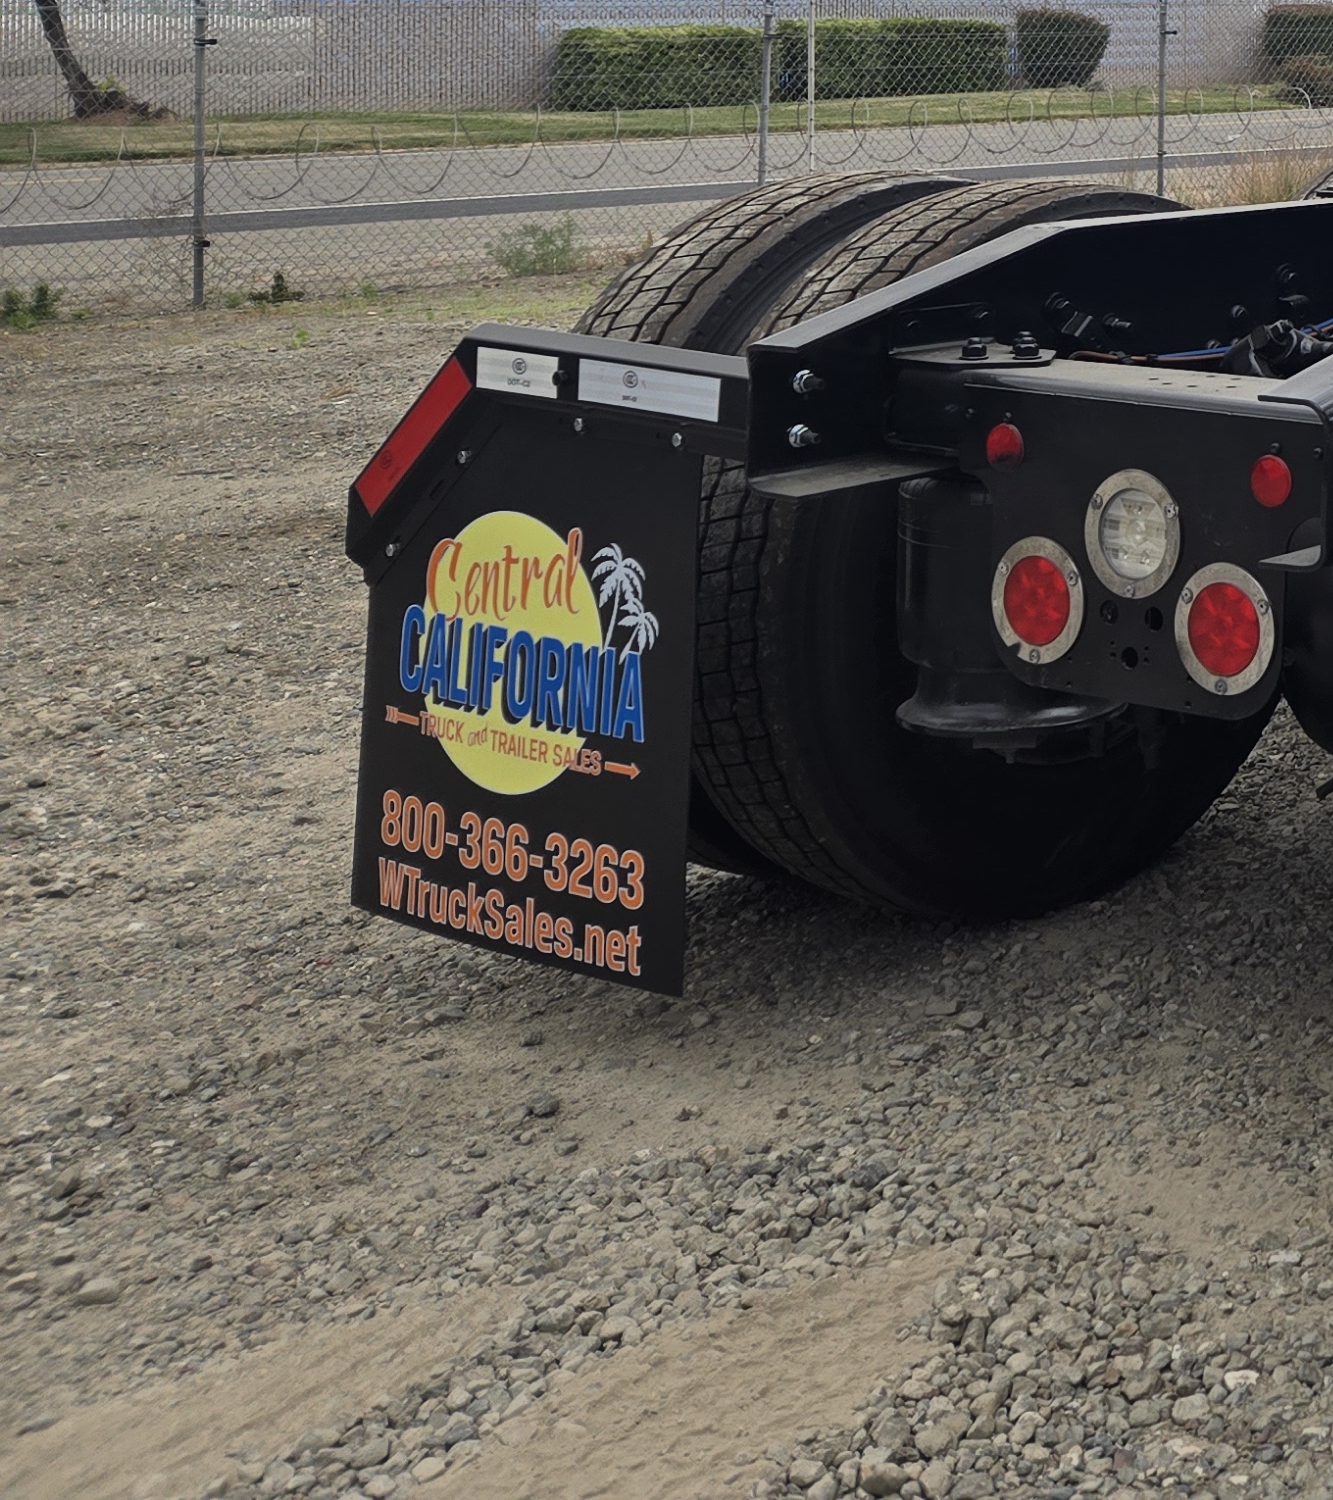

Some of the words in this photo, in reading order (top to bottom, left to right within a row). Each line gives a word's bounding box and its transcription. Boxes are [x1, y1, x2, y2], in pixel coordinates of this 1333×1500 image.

[426, 527, 583, 621] Central
[400, 604, 644, 743] CALIFORNIA
[420, 711, 464, 743] TRUCK
[468, 724, 487, 747] and
[491, 730, 548, 763] TRAILER
[553, 744, 602, 776] SALES
[381, 789, 644, 910] 800-366-3263
[378, 857, 642, 976] WTruckSales.net
